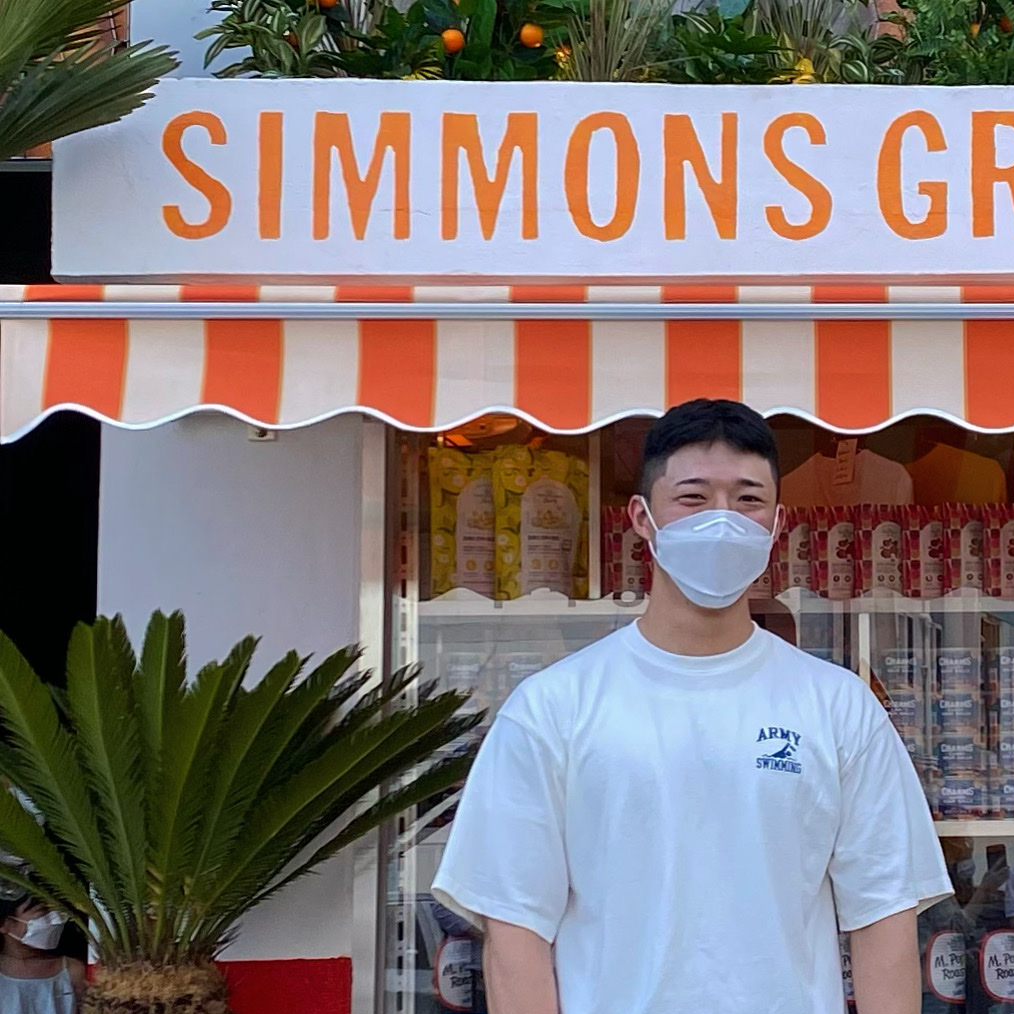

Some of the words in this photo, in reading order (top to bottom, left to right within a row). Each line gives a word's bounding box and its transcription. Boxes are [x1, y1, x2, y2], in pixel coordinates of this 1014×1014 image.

[162, 111, 831, 240] SIMMONS
[756, 727, 802, 746] ARMY
[756, 758, 802, 774] SWIMMING
